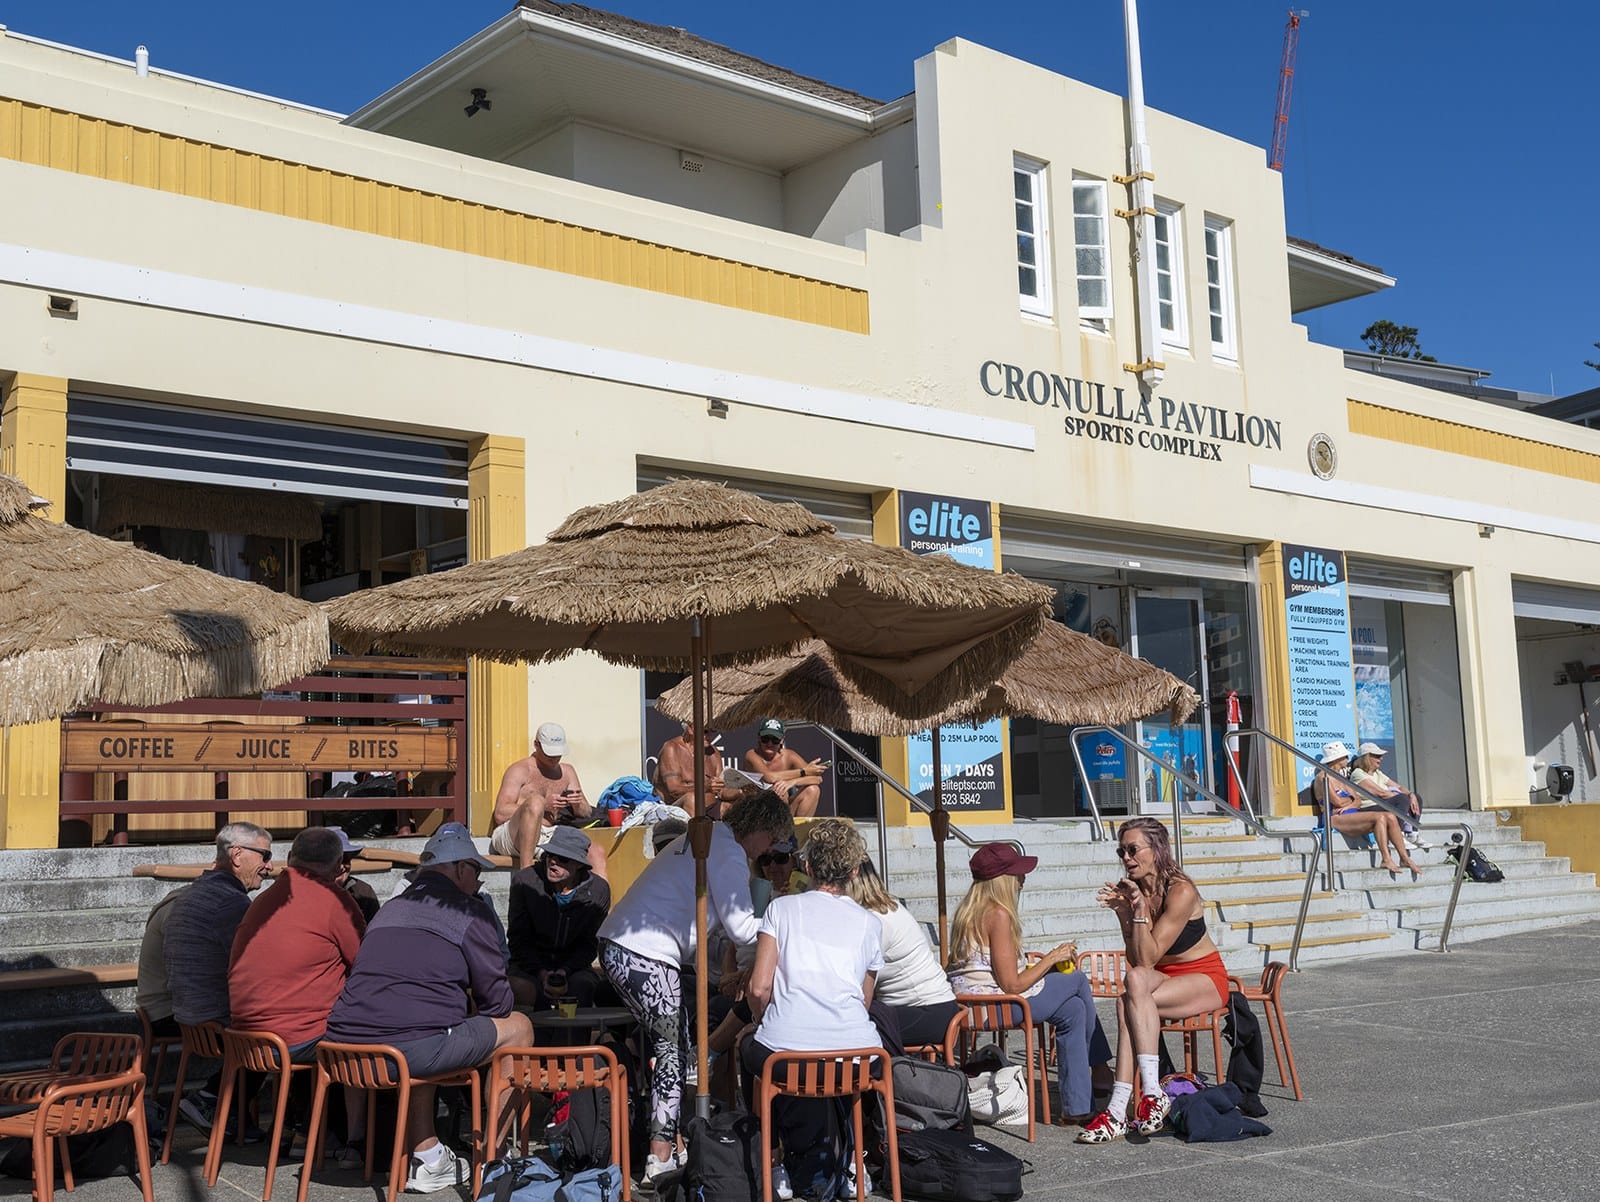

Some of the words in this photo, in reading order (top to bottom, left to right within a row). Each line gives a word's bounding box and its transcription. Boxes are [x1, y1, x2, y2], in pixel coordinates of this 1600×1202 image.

[979, 360, 1154, 426] CRONULLA
[1158, 396, 1281, 451] PAVILION
[1064, 416, 1134, 446] SPORTS
[1138, 430, 1222, 461] COMPLEX
[908, 501, 980, 541] elite
[911, 540, 949, 551] personal
[951, 542, 984, 557] training
[1288, 551, 1338, 584] elite
[1291, 584, 1317, 593] personal
[1290, 604, 1303, 612] GYM
[1304, 605, 1345, 617] MEMBERSHIPS
[1291, 615, 1306, 623] FULLY
[1307, 616, 1333, 625] EQUIPPED
[1334, 618, 1345, 626] GYM
[1316, 678, 1341, 686] MACHINES
[1322, 689, 1346, 697] TRAINING
[1297, 698, 1315, 706] GROUP
[1298, 709, 1318, 717] CRECHE
[1299, 720, 1318, 728] FOXTEL
[917, 734, 946, 743] HEAD
[948, 734, 962, 743] 25M
[963, 735, 978, 743] LAP
[979, 735, 999, 743] POOL
[1310, 731, 1345, 739] CONDITIONING
[99, 737, 175, 759] COFFEE
[236, 739, 291, 759] JUICE
[348, 739, 399, 759] BITES
[955, 764, 962, 777] 7
[965, 763, 995, 777] DAYS
[941, 793, 958, 805] 523
[959, 793, 981, 805] 5842
